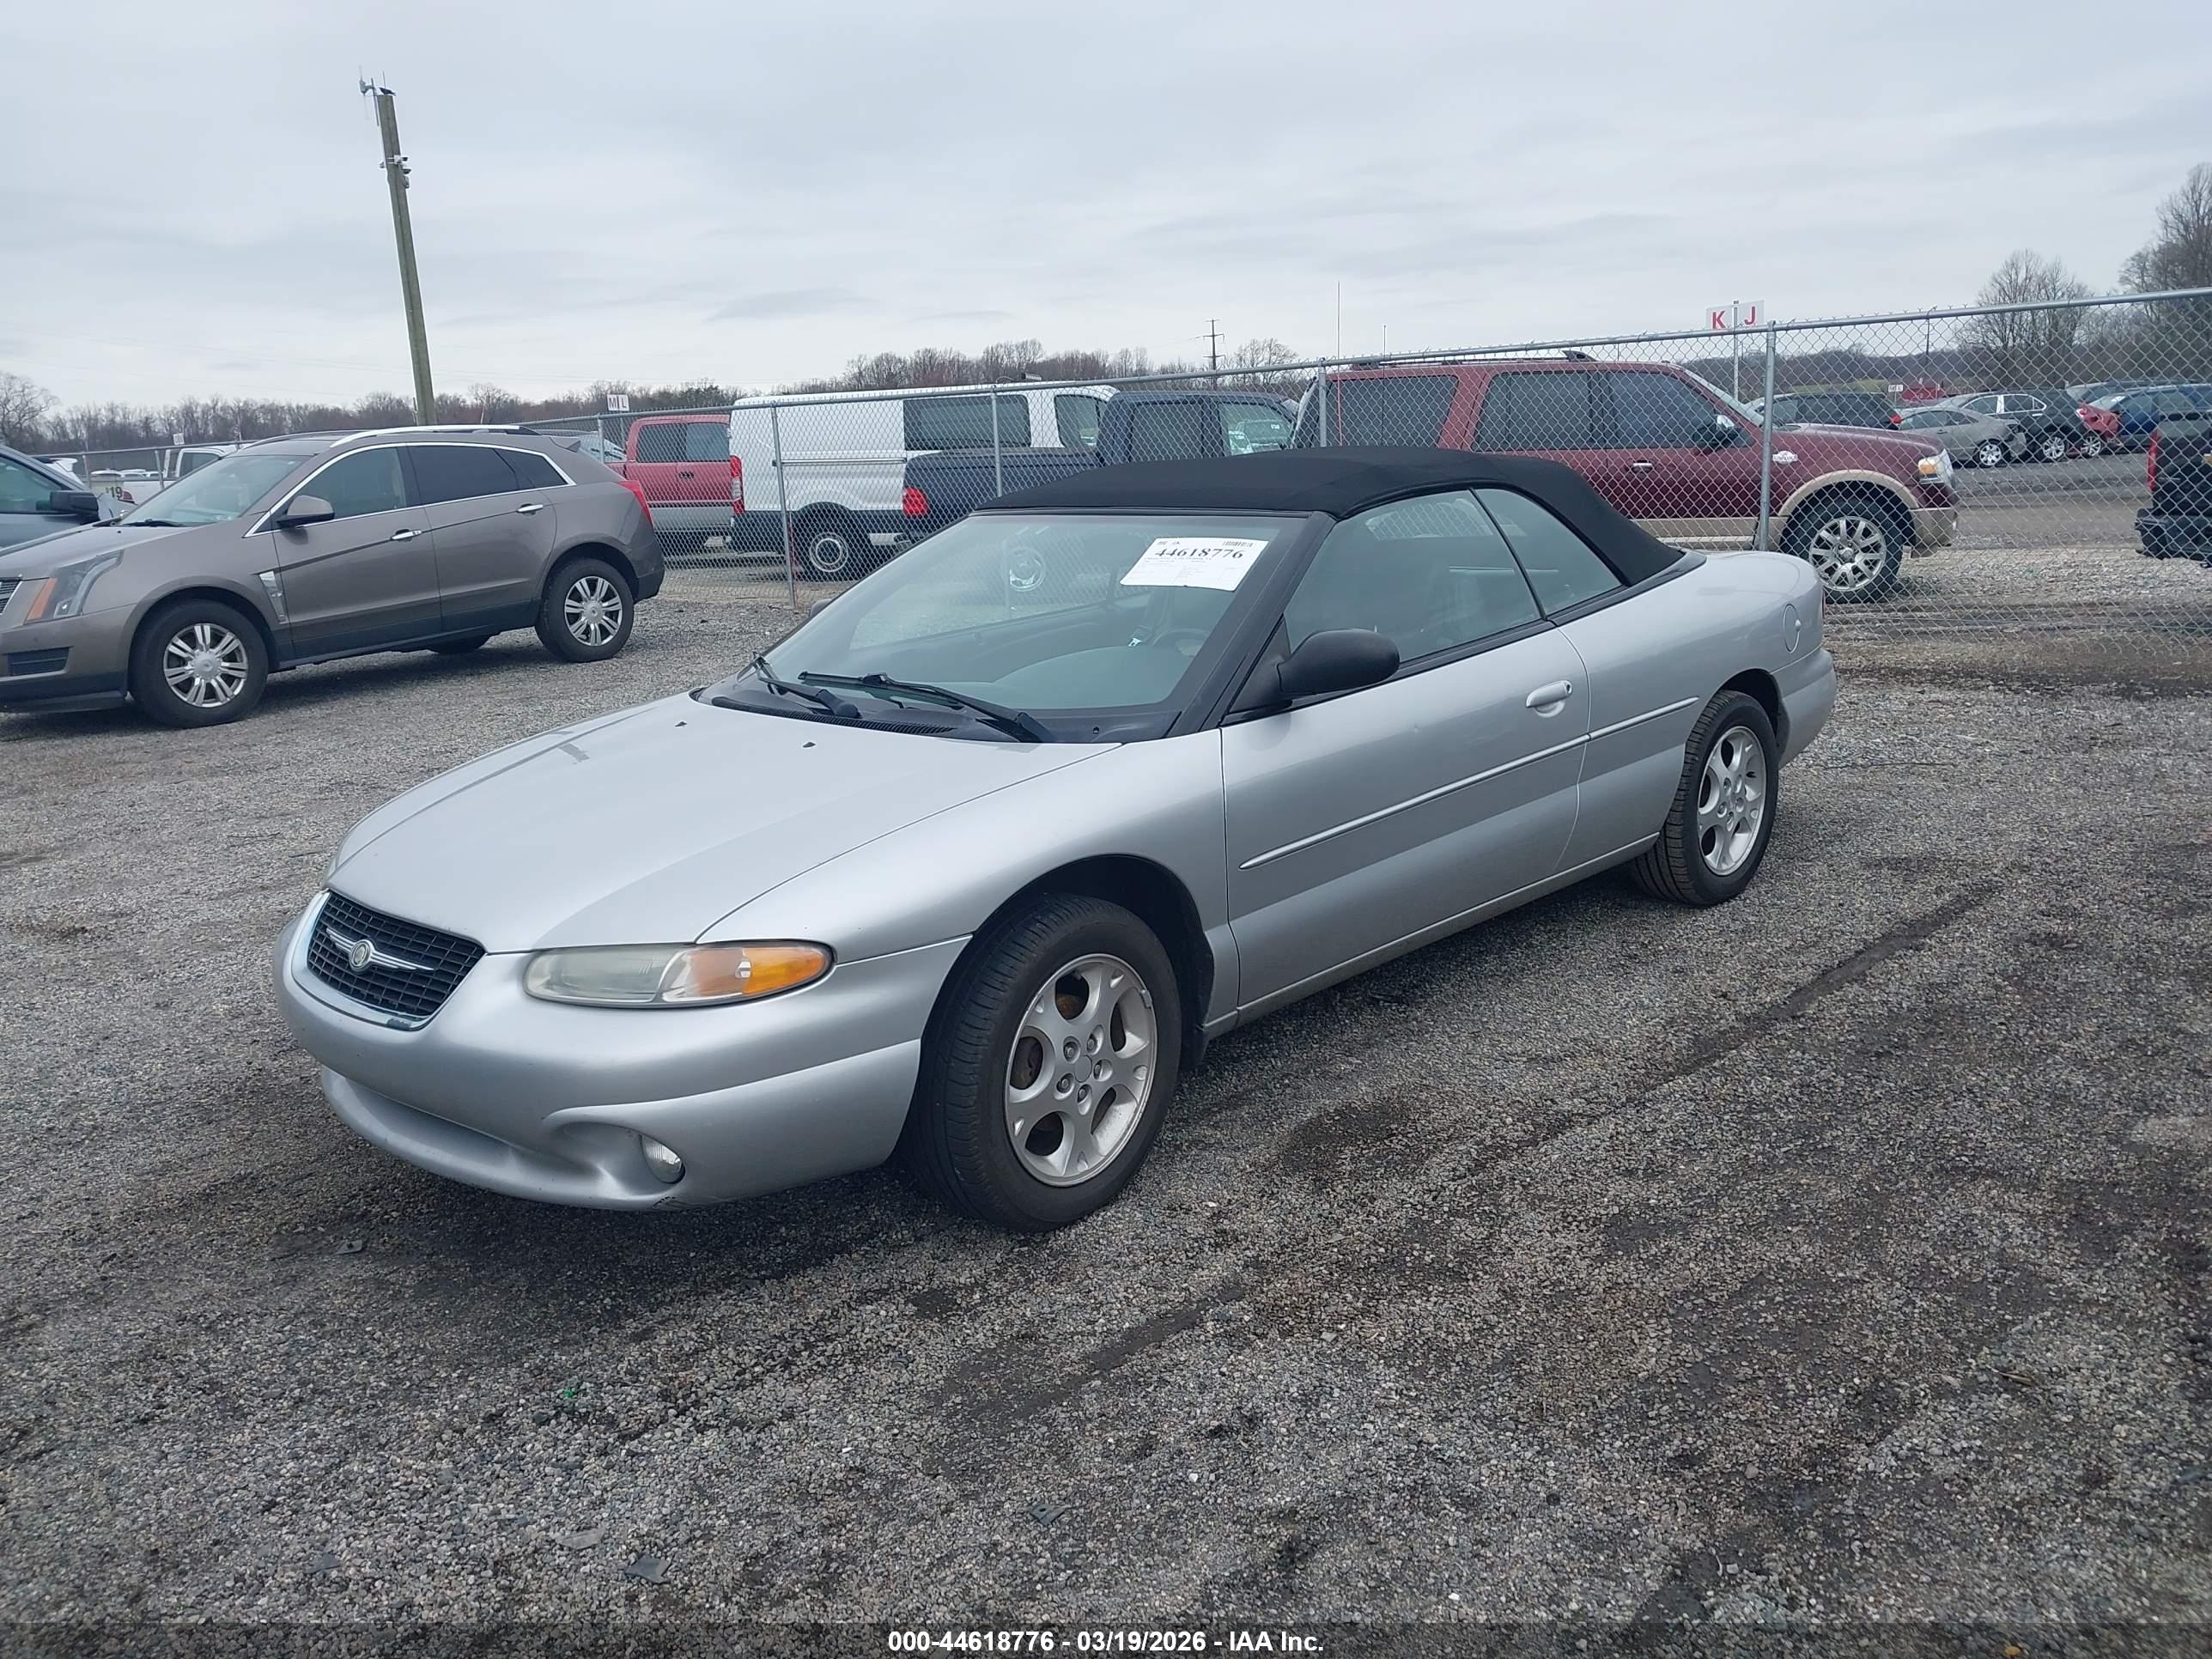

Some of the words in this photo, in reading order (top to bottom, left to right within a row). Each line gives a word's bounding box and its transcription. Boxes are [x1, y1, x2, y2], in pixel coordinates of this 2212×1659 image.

[1712, 310, 1726, 329] K
[1744, 306, 1756, 325] J
[1155, 548, 1245, 559] 44618776
